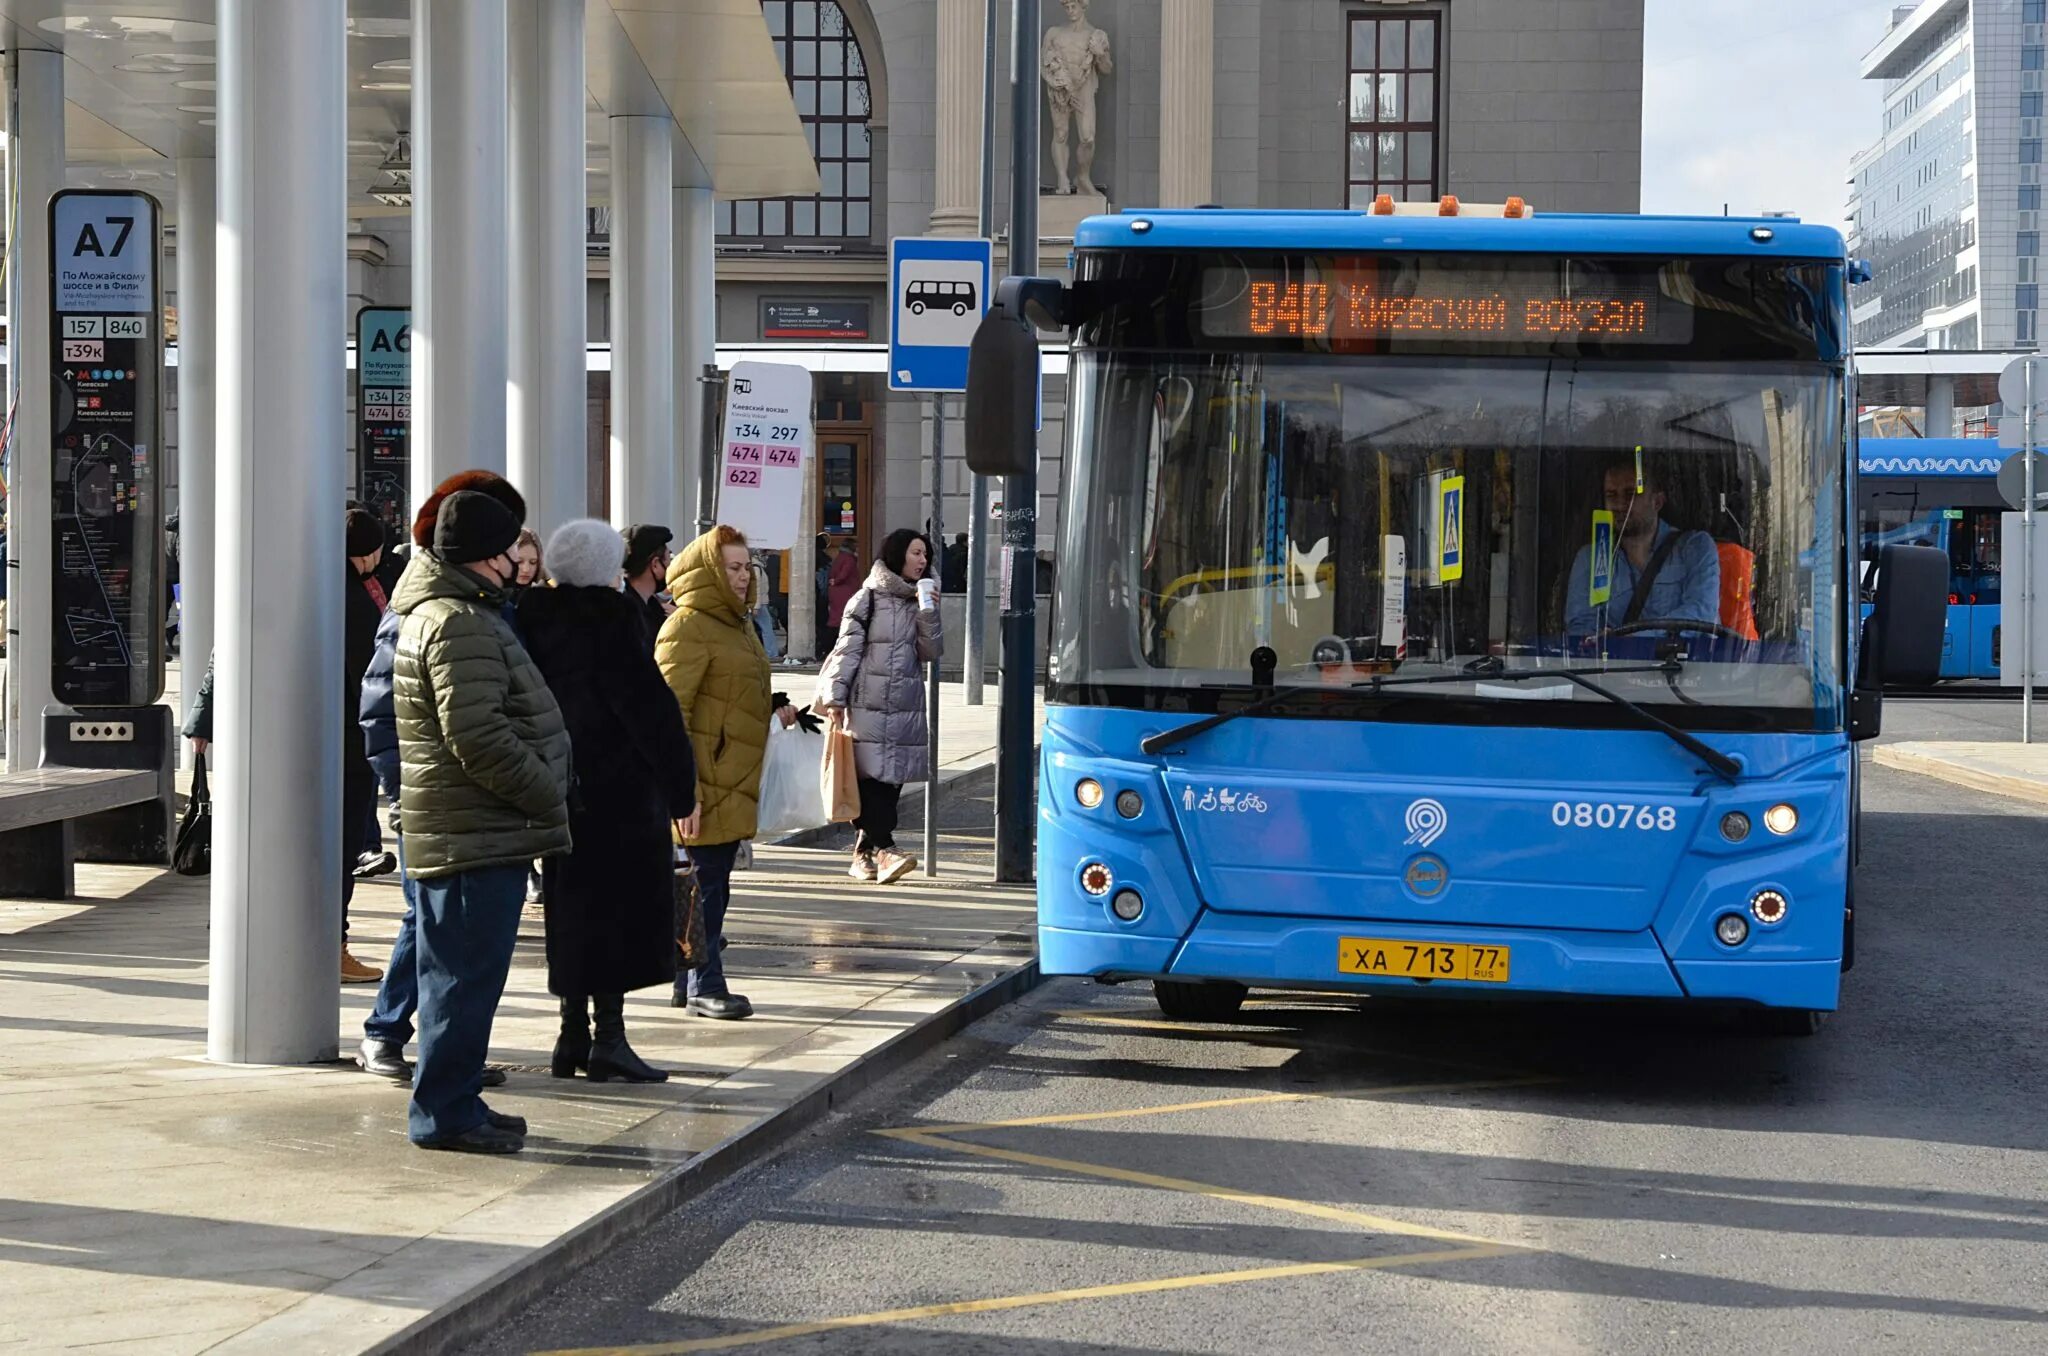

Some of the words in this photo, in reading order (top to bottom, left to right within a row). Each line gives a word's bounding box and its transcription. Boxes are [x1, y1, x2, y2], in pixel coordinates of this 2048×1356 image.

[73, 217, 135, 257] А7
[63, 271, 77, 280] По
[79, 271, 146, 281] Можайскому
[112, 281, 139, 290] Фили
[1251, 283, 1327, 333] 840
[1351, 284, 1505, 331] Киевский
[1526, 300, 1645, 332] вокзал
[71, 321, 96, 333] 157
[110, 321, 142, 334] 840
[65, 344, 102, 357] т39к
[369, 391, 388, 402] т34
[398, 392, 411, 402] 29
[368, 408, 389, 418] 474
[397, 408, 411, 418] 62
[732, 403, 764, 412] Киевский
[735, 424, 760, 438] т34
[771, 426, 798, 440] 297
[731, 447, 760, 461] 474
[768, 450, 796, 464] 474
[730, 470, 757, 484] 622
[1552, 801, 1677, 831] 080768
[1355, 949, 1387, 970] ХА
[1404, 946, 1454, 973] 713
[1472, 948, 1499, 969] 77
[1473, 969, 1494, 978] RUS
